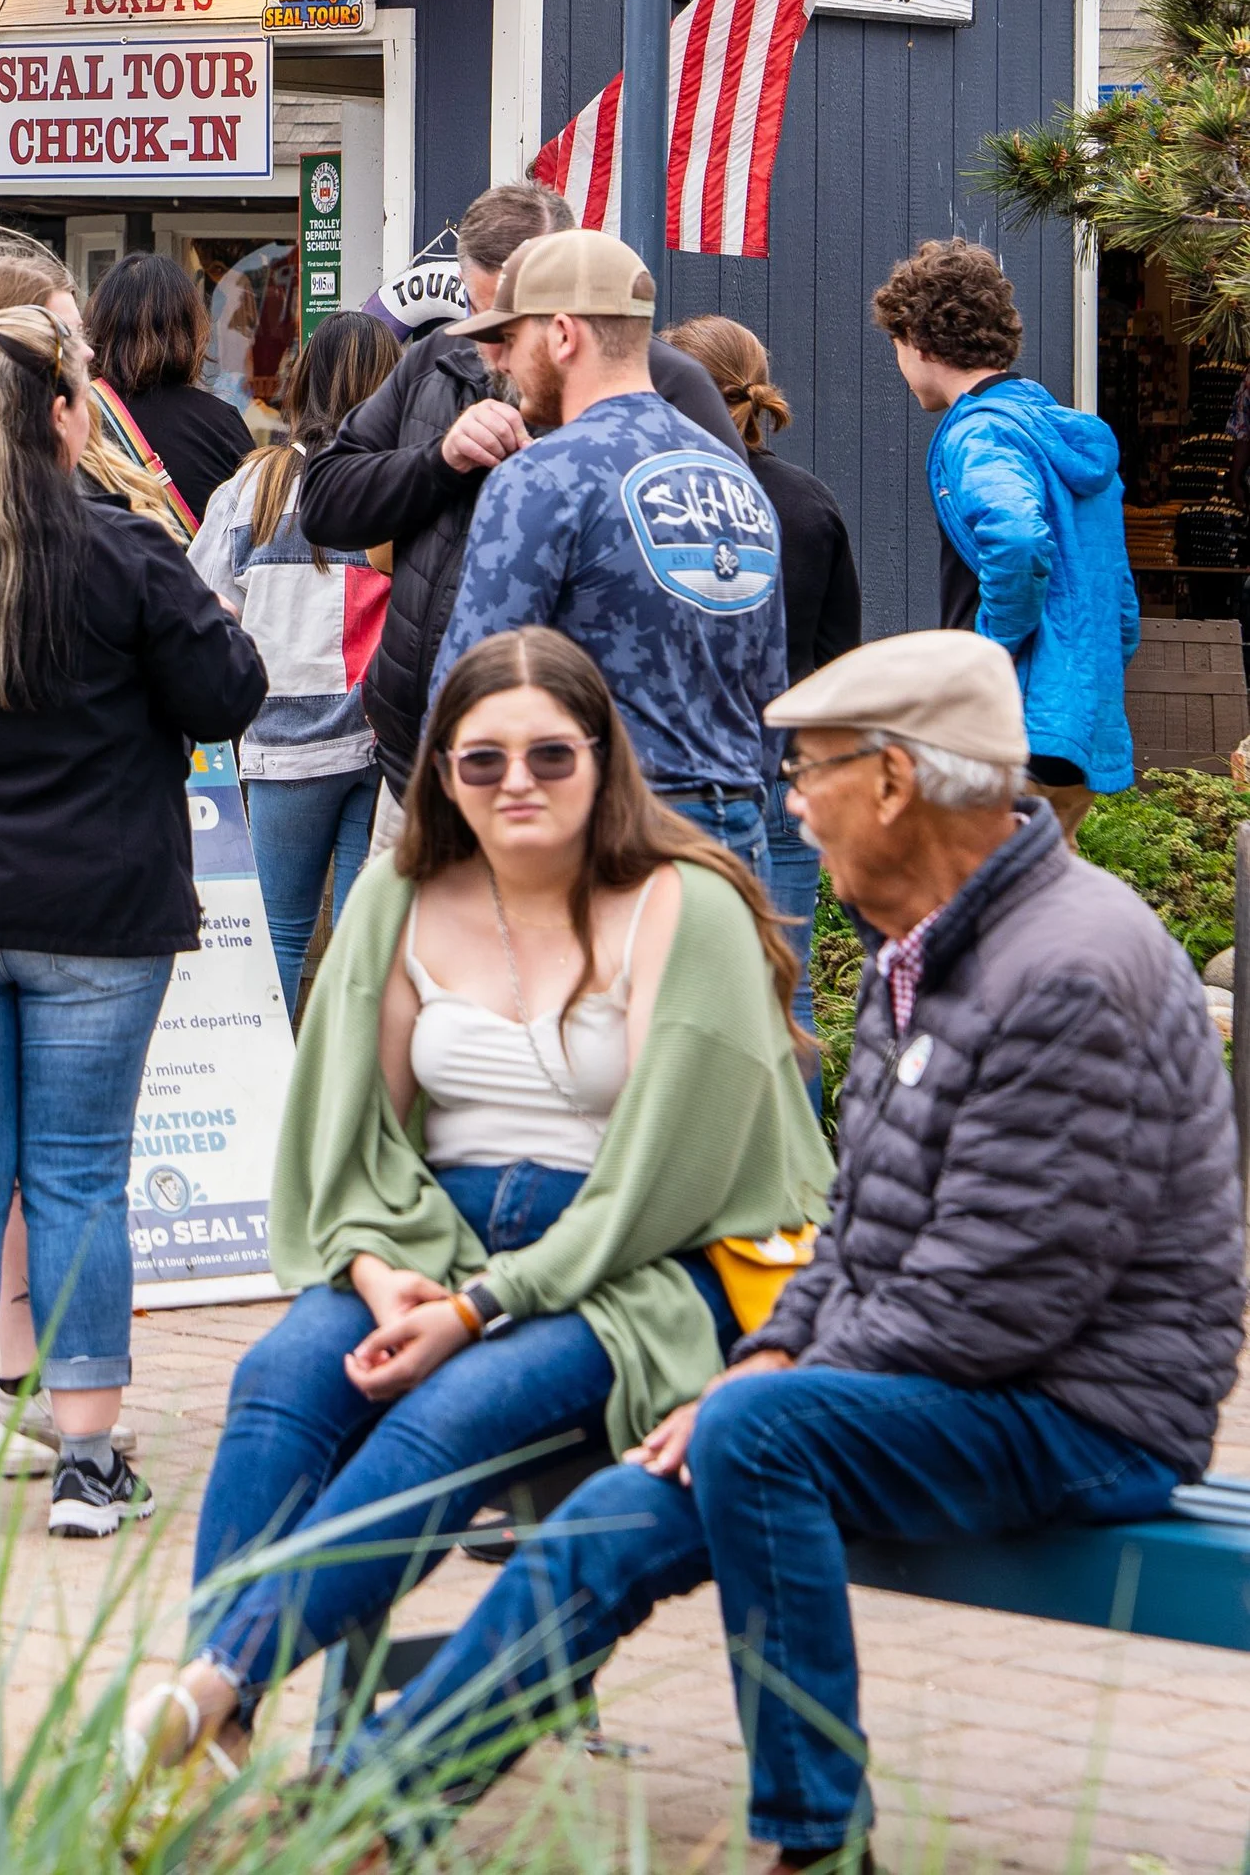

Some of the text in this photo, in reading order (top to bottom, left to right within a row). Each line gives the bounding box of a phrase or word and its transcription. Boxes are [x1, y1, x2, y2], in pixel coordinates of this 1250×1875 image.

[265, 5, 360, 26] SEAL TOURS
[123, 51, 257, 99] TOUR
[9, 115, 241, 165] CHECK-IN
[309, 218, 340, 230] TROLLEY
[305, 230, 342, 241] DEPARTUR
[312, 276, 327, 290] 9:05
[217, 933, 253, 948] time
[177, 968, 191, 981] in
[190, 1012, 262, 1031] departing
[156, 1061, 216, 1077] minutes
[147, 1082, 182, 1097] time
[134, 1108, 237, 1132] VATIONS
[131, 1131, 227, 1157] QUIRED
[173, 1216, 247, 1245] SEAL
[158, 1259, 166, 1268] a
[189, 1252, 222, 1267] please
[223, 1250, 241, 1263] call
